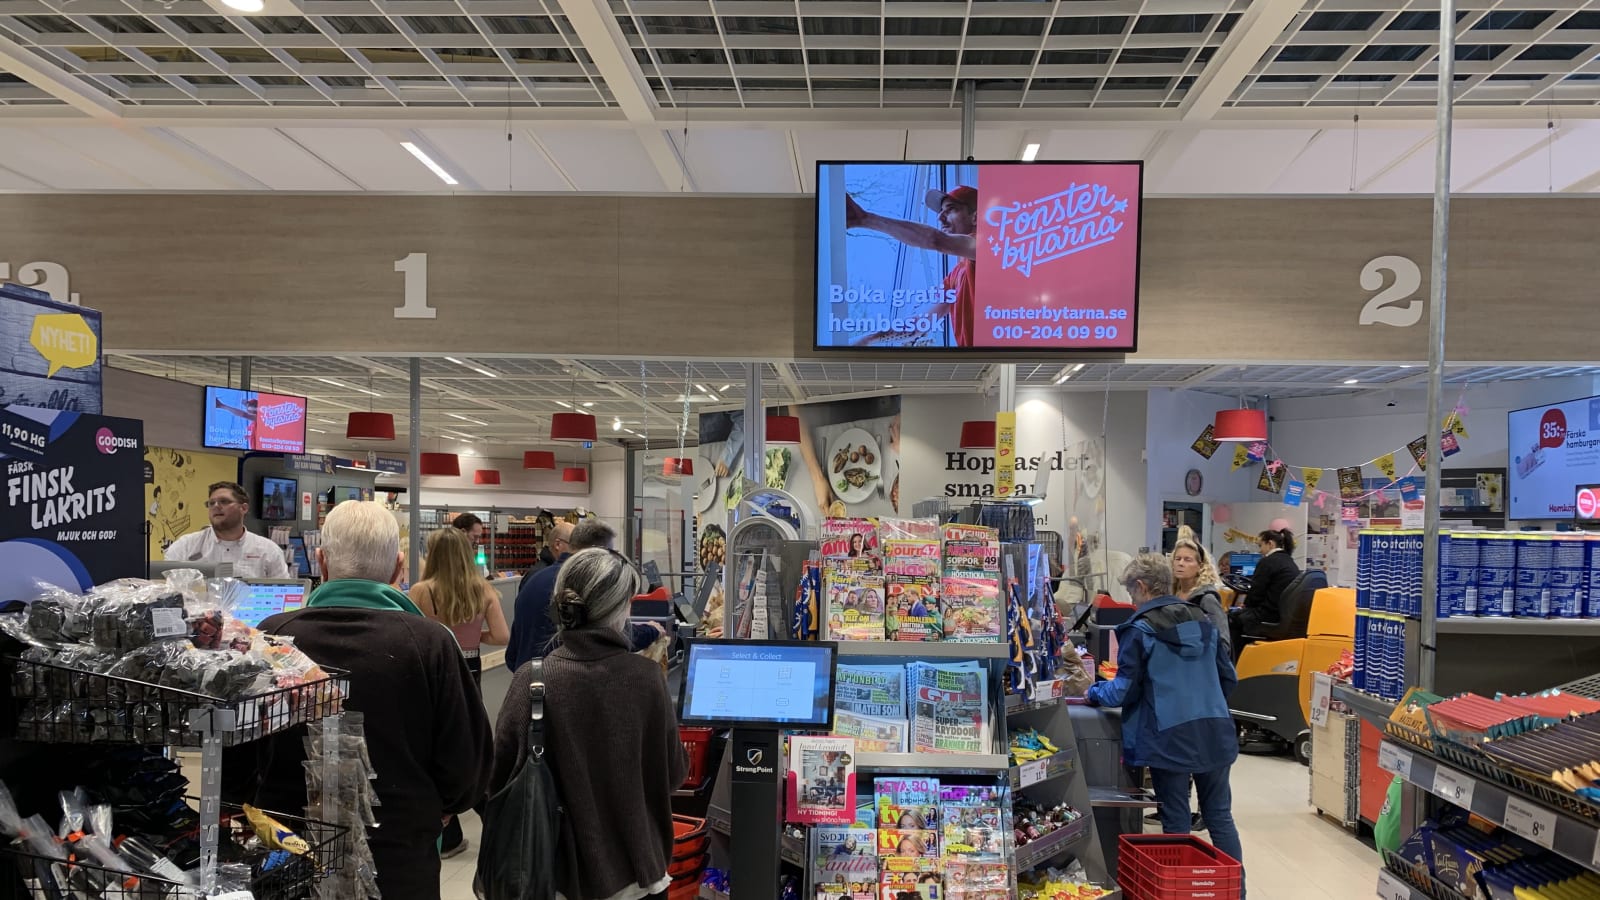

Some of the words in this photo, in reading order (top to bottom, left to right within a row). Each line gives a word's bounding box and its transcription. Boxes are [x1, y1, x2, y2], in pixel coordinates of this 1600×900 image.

[985, 182, 1115, 241] Fönster
[1002, 215, 1123, 277] bytarna
[394, 252, 436, 318] 1
[1359, 255, 1423, 327] 2
[828, 284, 886, 304] Boka
[892, 285, 957, 308] gratis
[984, 305, 1127, 322] fonsterbytarna.se
[828, 313, 945, 333] hembesök
[38, 325, 91, 354] NYHET!
[992, 325, 1062, 340] 010-204
[1067, 325, 1090, 340] 09
[1094, 325, 1118, 340] 90
[2, 423, 28, 442] 11,90
[30, 433, 46, 448] HG
[98, 436, 137, 449] GOODISH
[7, 461, 34, 475] FÄRSK
[8, 466, 75, 506] FINSK
[31, 484, 116, 530] LAKRITS
[57, 531, 80, 542] MJUK
[81, 531, 97, 541] OCH
[98, 530, 117, 541] GOD!
[946, 557, 979, 565] SOPPOR
[984, 556, 997, 565] 49
[732, 652, 751, 660] Select
[853, 703, 880, 716] MATEN
[881, 705, 900, 717] SOM
[935, 716, 962, 727] SUPER-
[735, 765, 773, 774] StrongPoint
